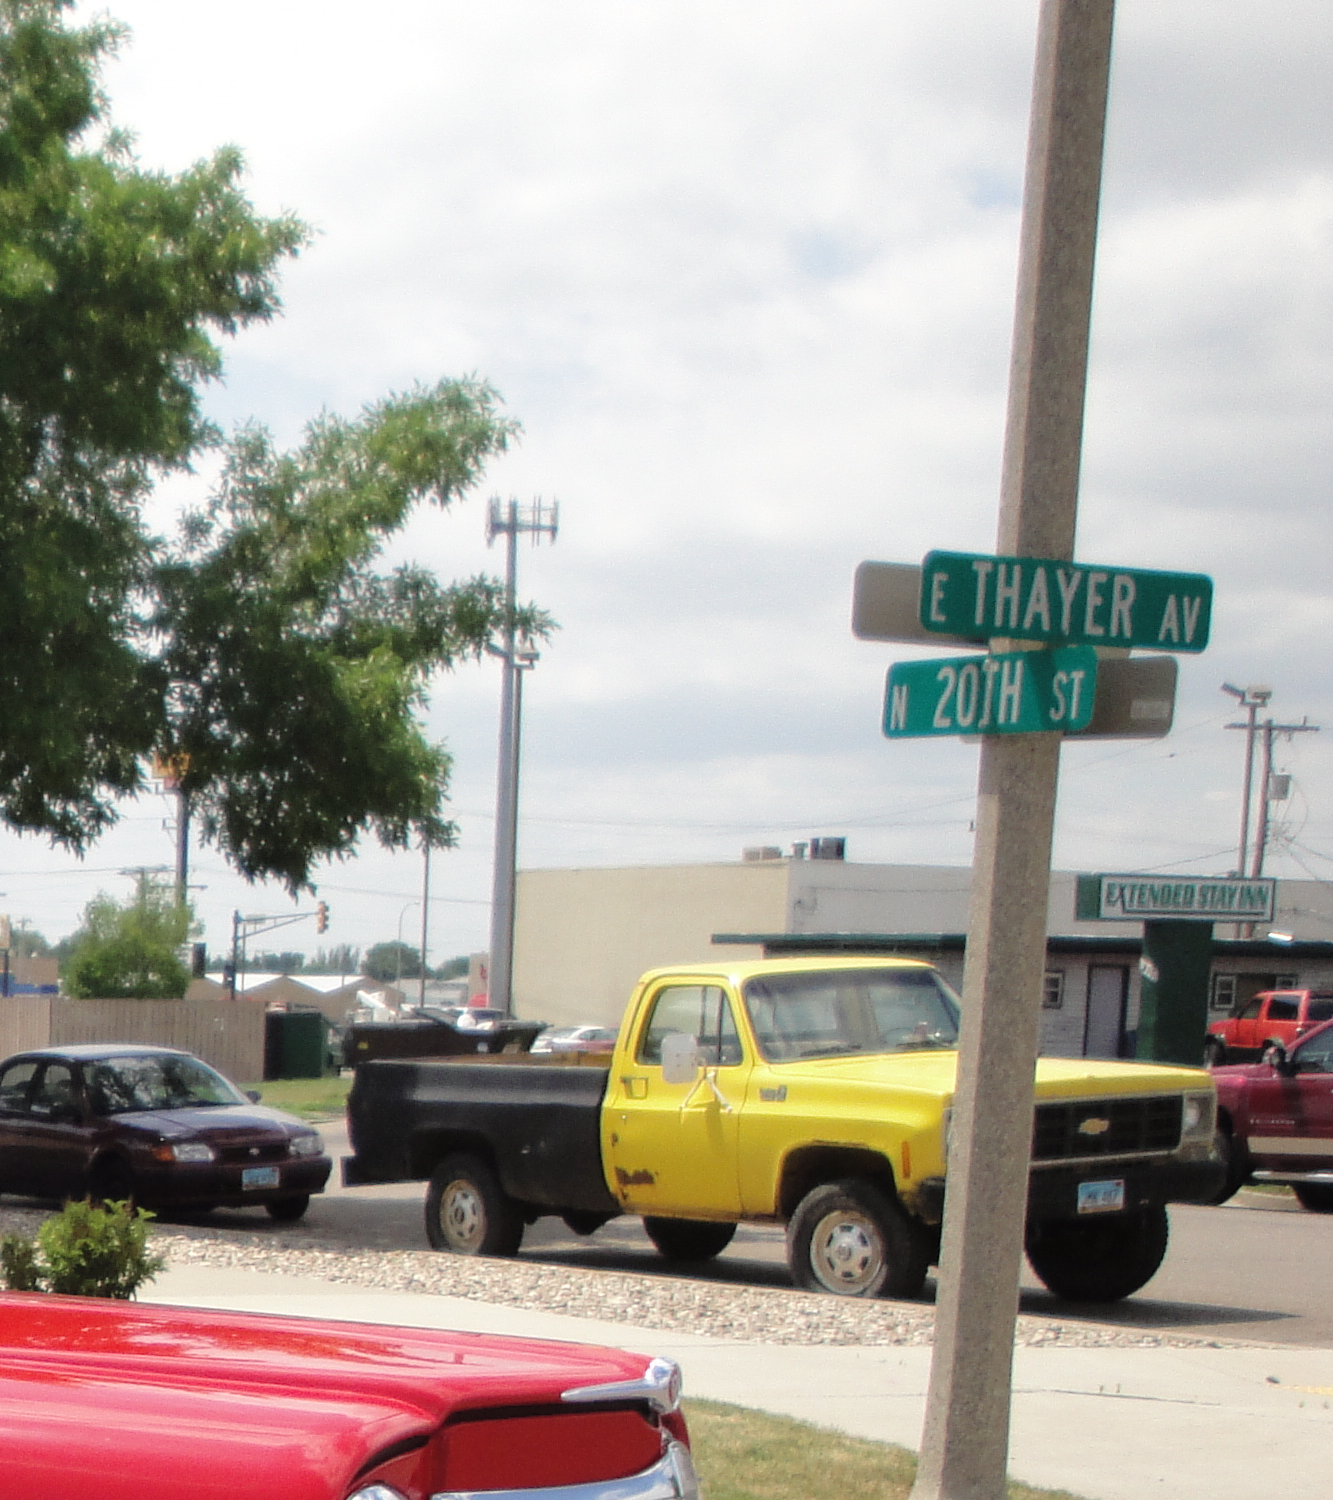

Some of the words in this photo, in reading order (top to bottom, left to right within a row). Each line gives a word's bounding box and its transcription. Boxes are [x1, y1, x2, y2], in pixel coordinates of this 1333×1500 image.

[931, 572, 949, 623] E
[973, 560, 1137, 639] THAYER
[1158, 594, 1201, 644] AV
[890, 685, 908, 730] N
[933, 659, 1024, 729] 20TH
[1049, 670, 1085, 721] ST
[1106, 881, 1197, 906] EXTENDED
[1199, 884, 1238, 909] STAY
